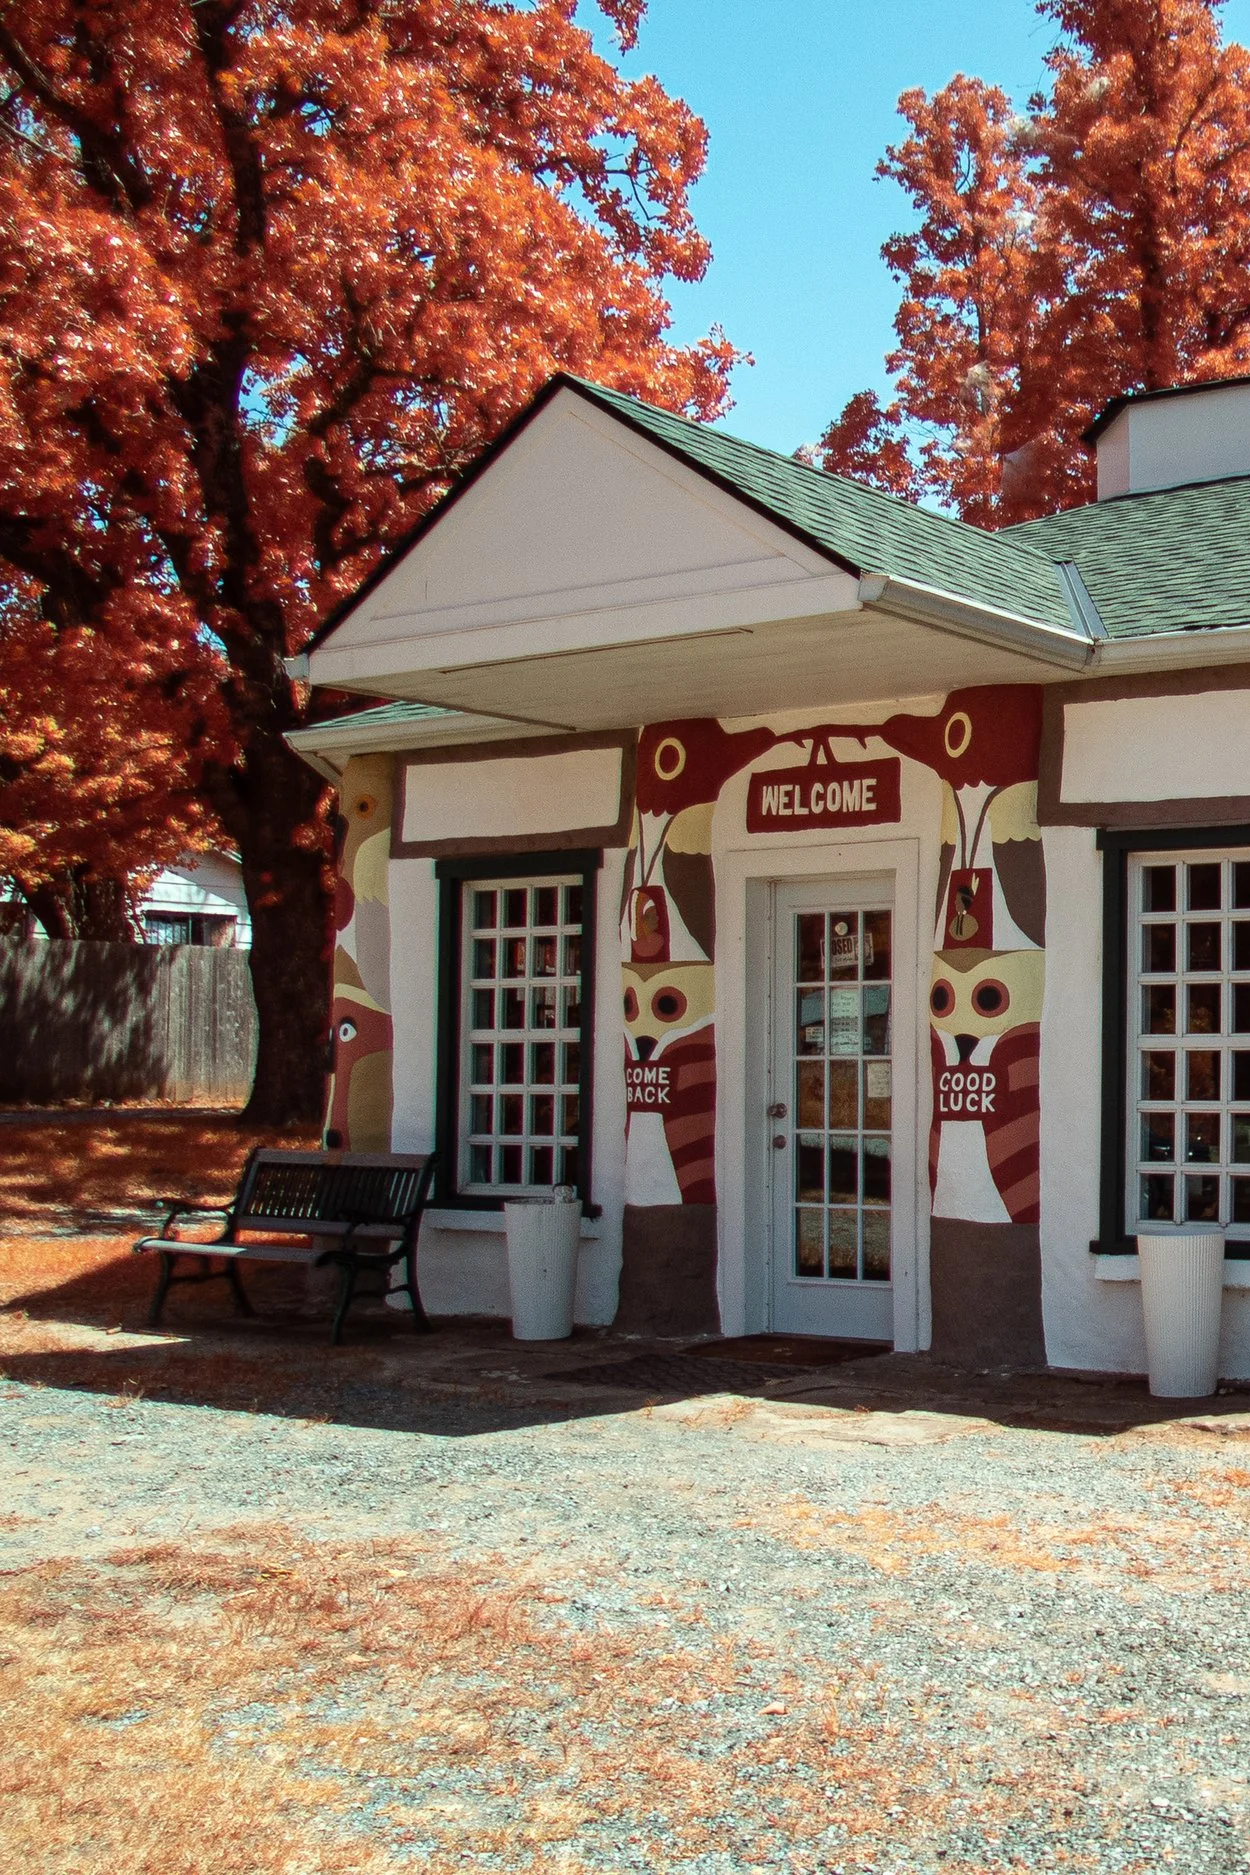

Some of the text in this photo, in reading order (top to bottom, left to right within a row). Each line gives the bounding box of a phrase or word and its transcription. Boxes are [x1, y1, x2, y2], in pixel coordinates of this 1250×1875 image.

[762, 778, 877, 816] WELCOME
[821, 938, 854, 956] OSED
[626, 1067, 671, 1084] COME
[939, 1071, 996, 1092] GOOD
[627, 1086, 671, 1103] BACK
[939, 1092, 996, 1113] LUCK
